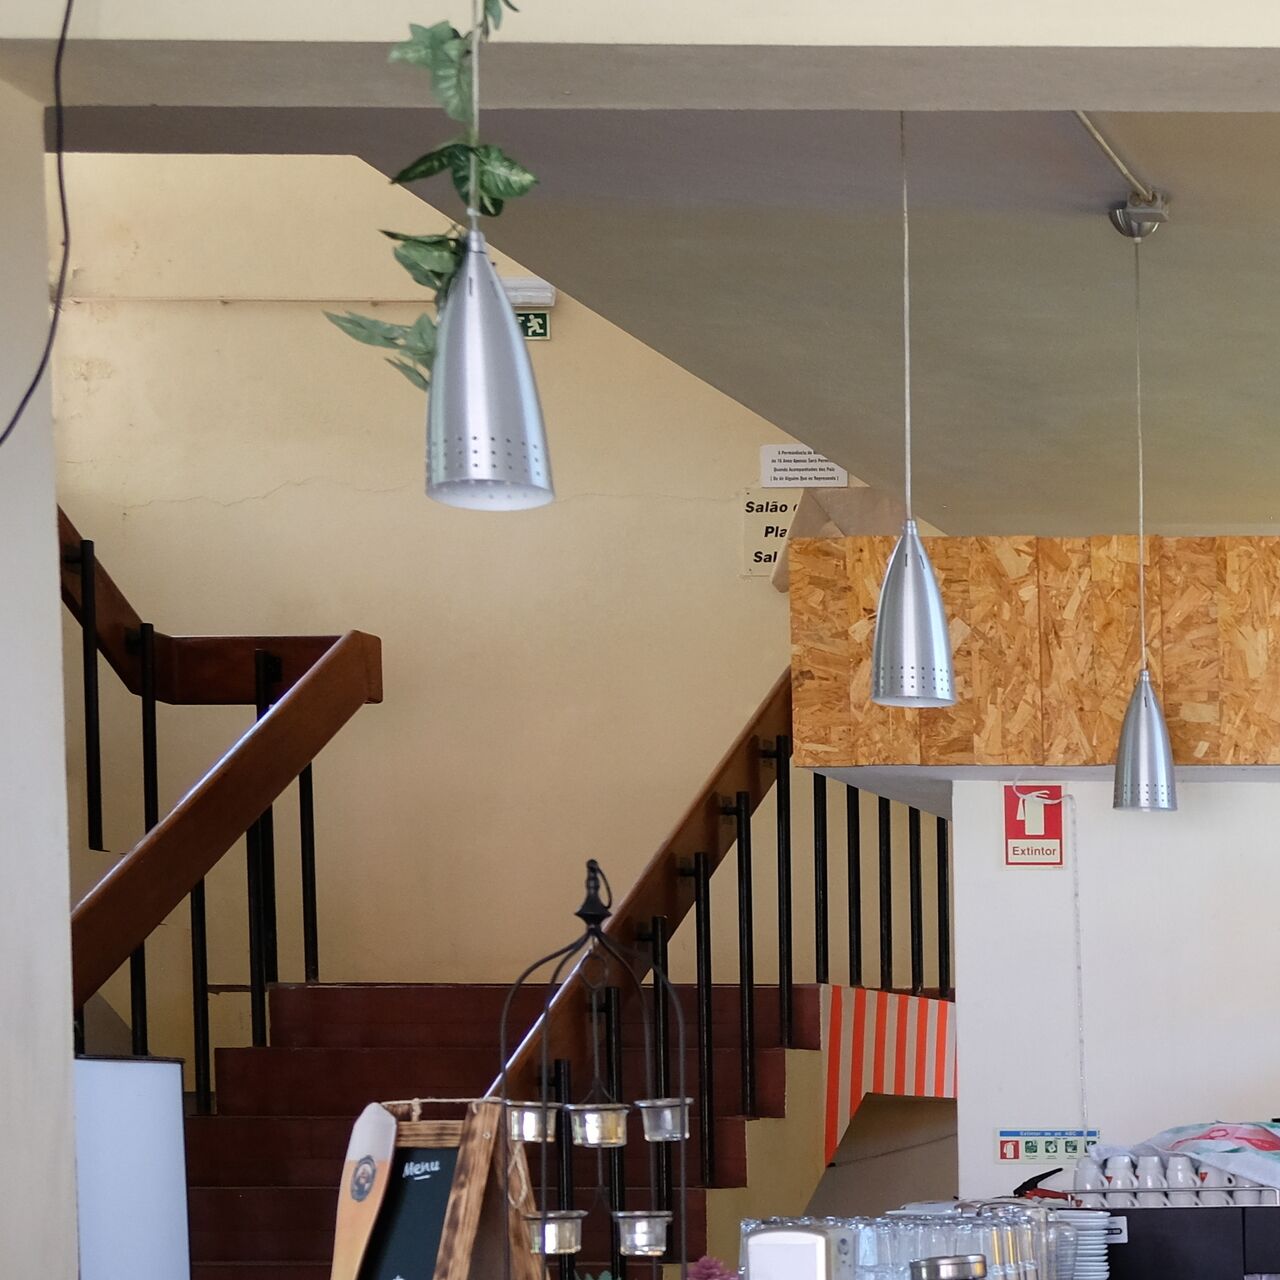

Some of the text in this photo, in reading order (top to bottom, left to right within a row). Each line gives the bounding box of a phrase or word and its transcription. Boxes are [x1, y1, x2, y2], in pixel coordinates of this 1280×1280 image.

[745, 501, 788, 513] Salão
[753, 551, 777, 563] Sal
[1012, 846, 1056, 856] Extintor
[402, 1160, 441, 1178] Menu
